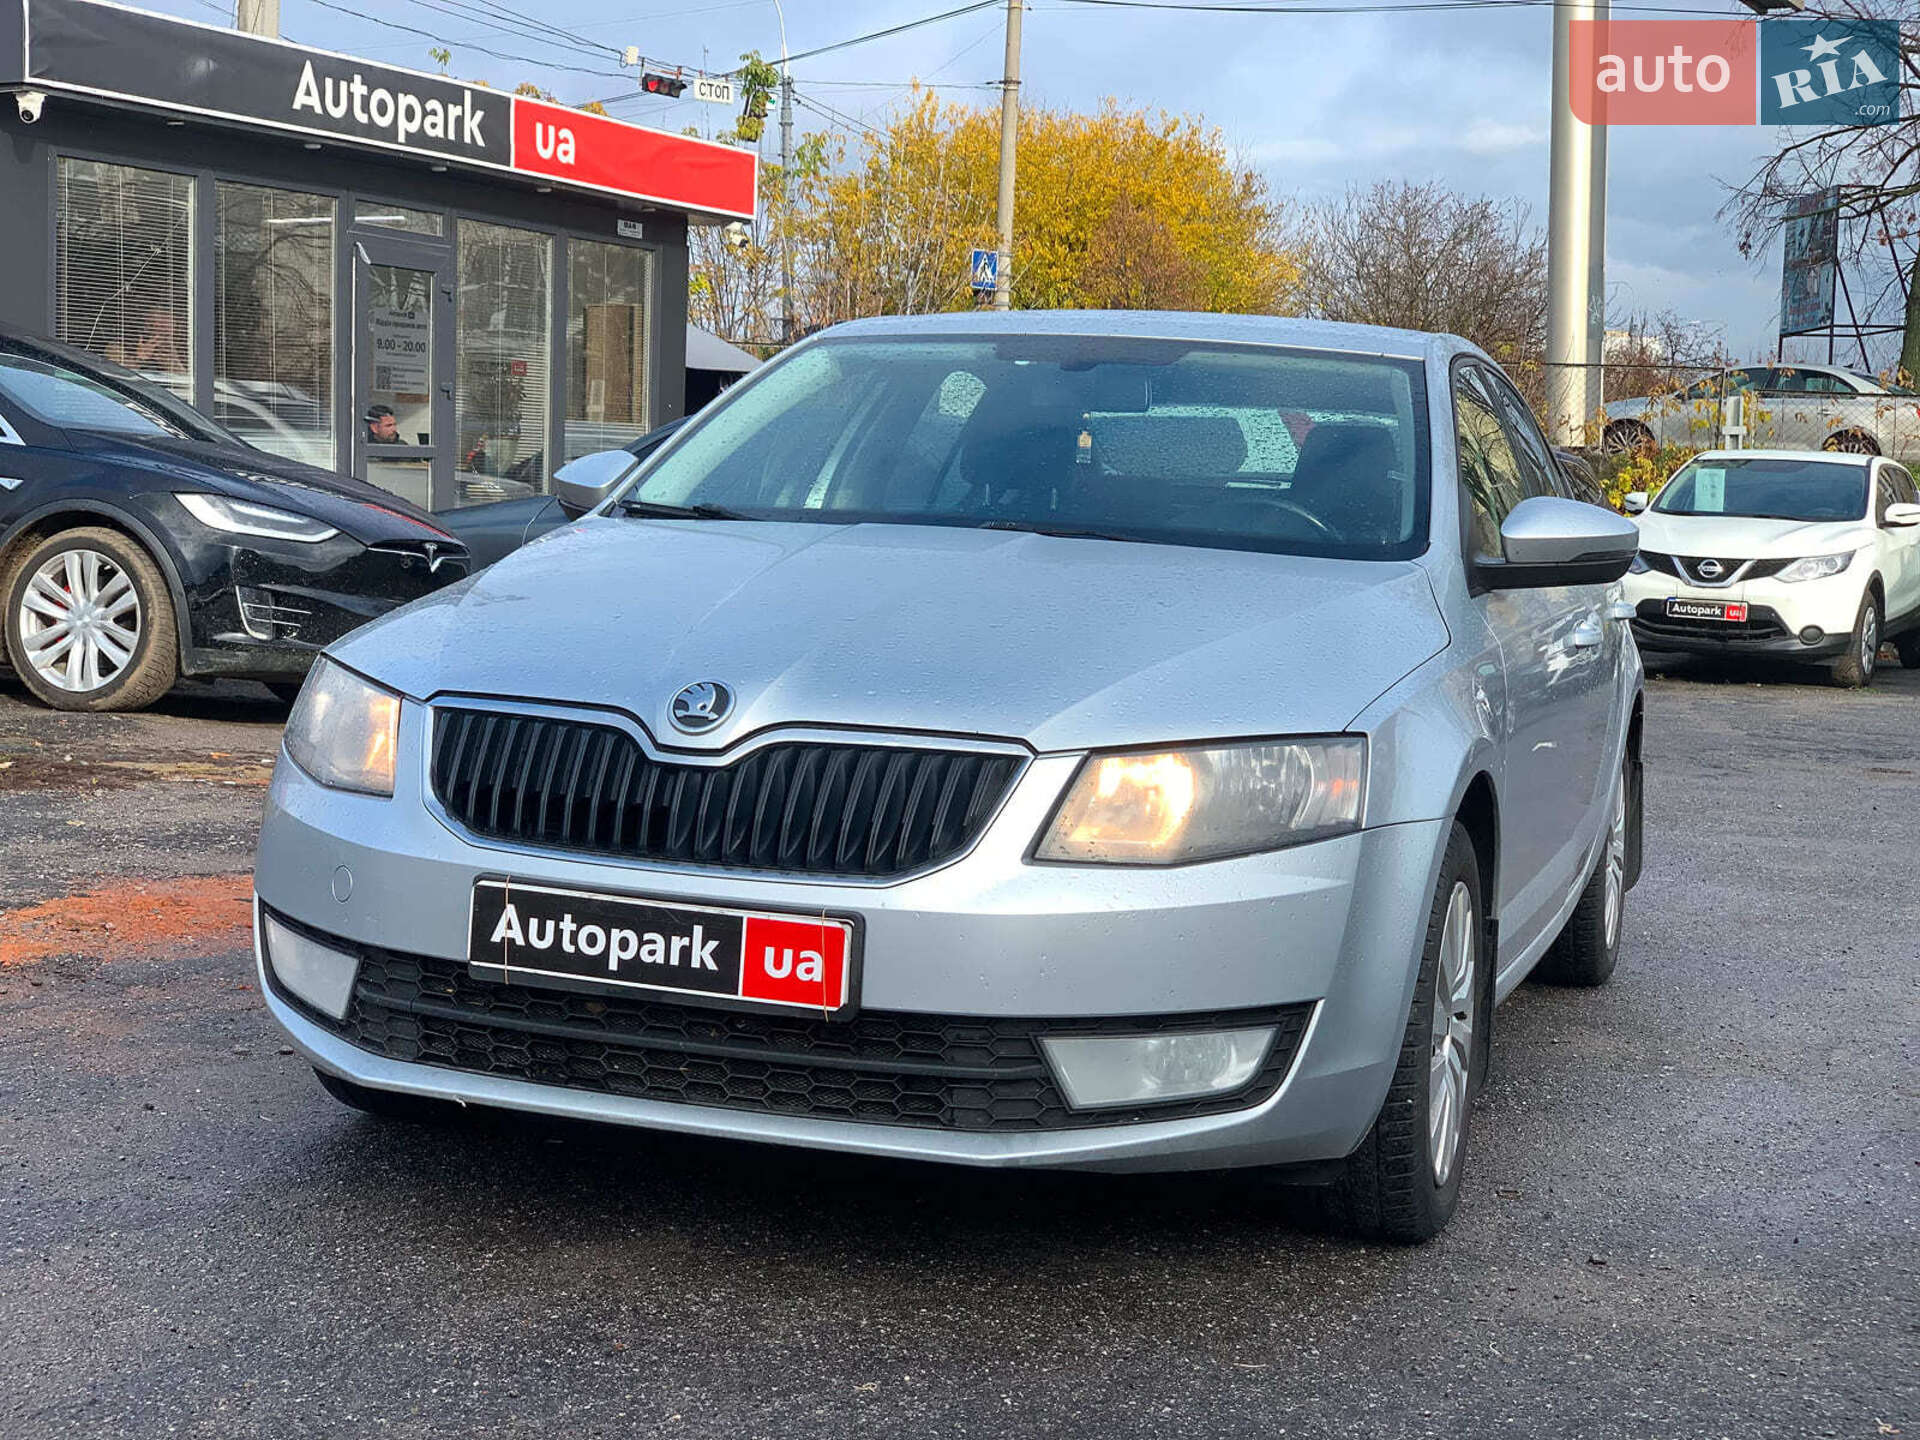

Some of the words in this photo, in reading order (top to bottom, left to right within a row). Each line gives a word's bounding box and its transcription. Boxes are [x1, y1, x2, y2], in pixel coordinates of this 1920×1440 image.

[698, 82, 731, 101] СТОП
[292, 60, 486, 147] Autopark
[535, 121, 576, 166] ua
[403, 341, 426, 352] 20.00
[1672, 603, 1721, 616] Autopark
[490, 903, 721, 972] Autopark
[763, 945, 824, 983] ua
